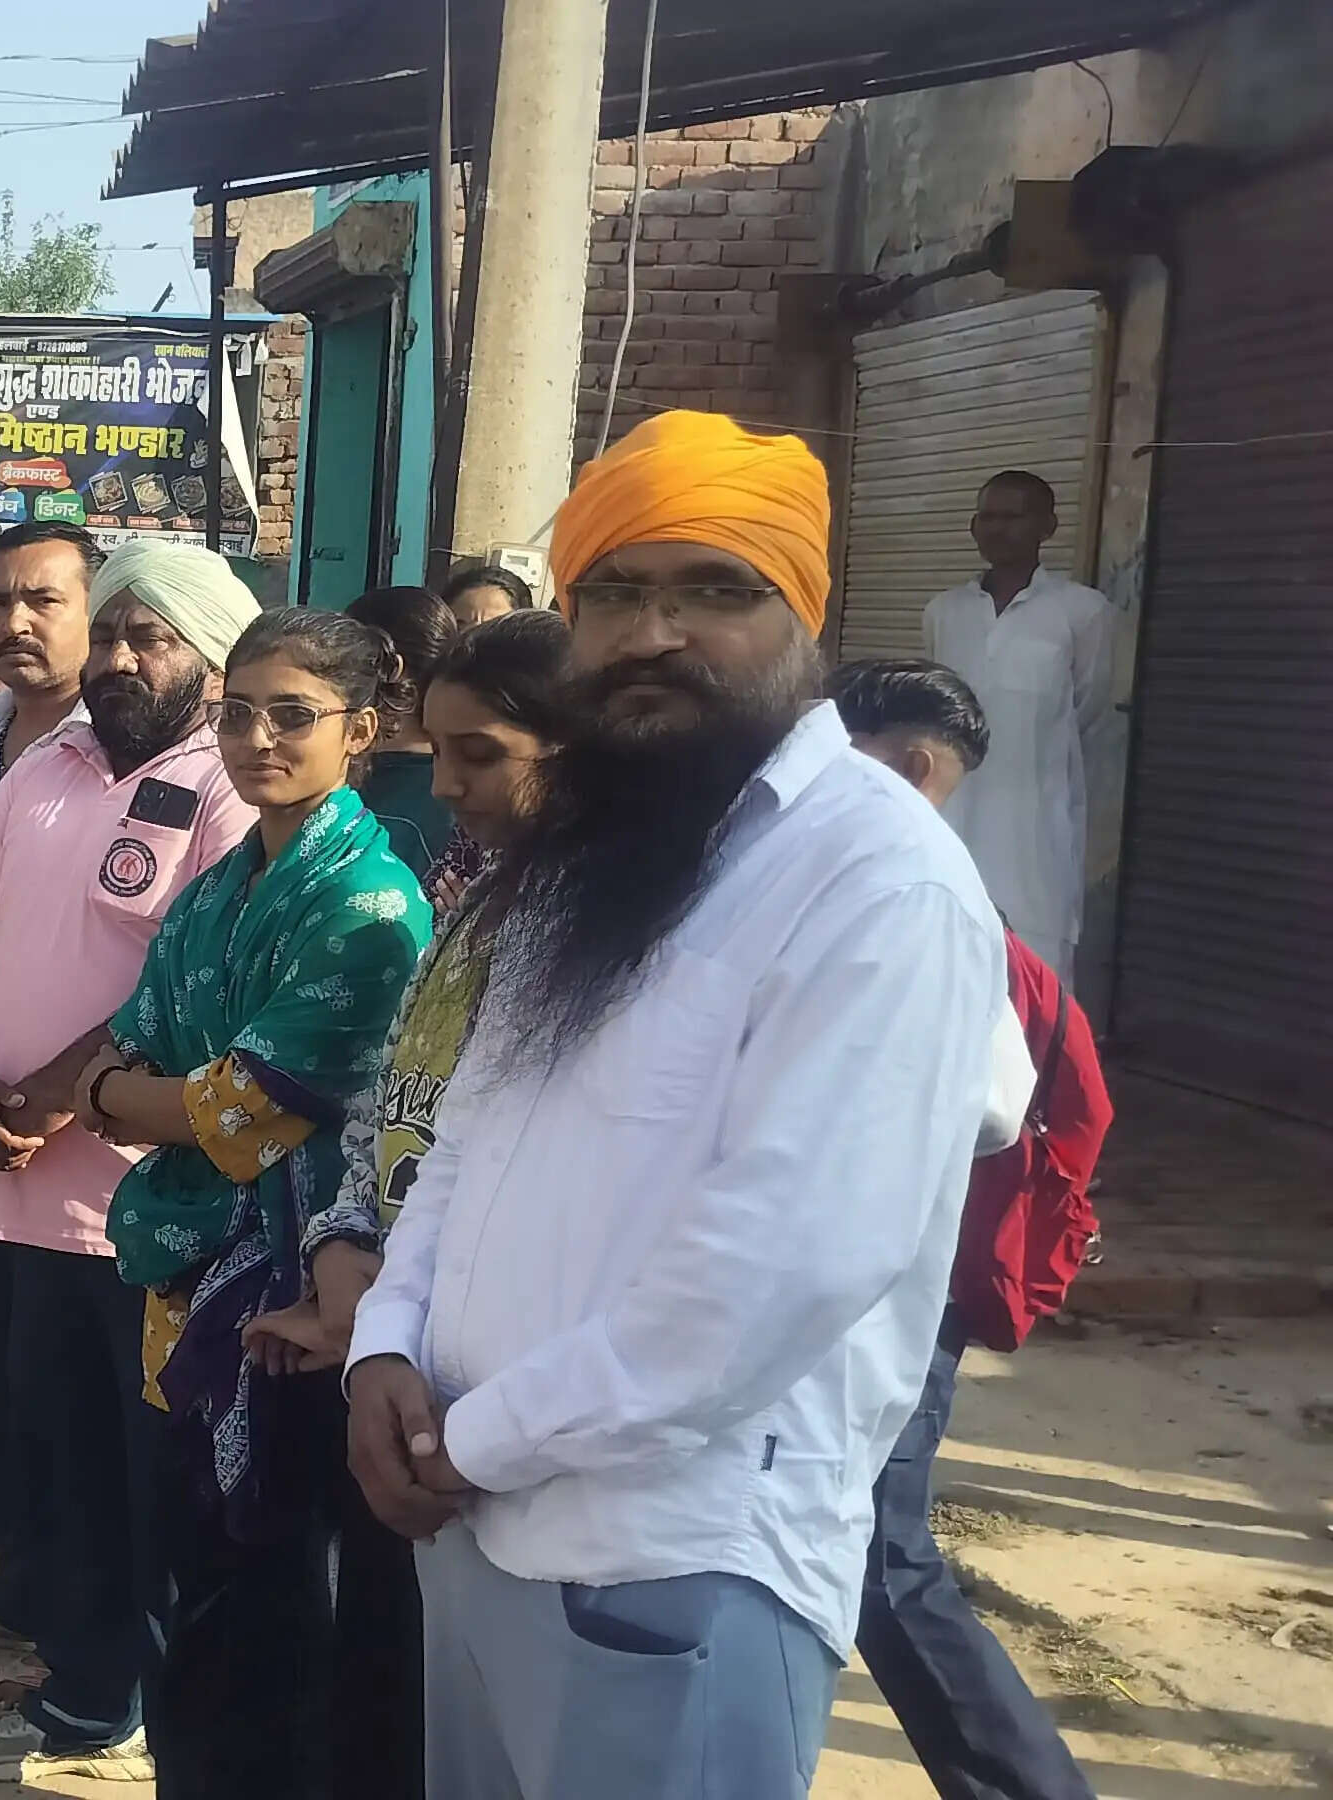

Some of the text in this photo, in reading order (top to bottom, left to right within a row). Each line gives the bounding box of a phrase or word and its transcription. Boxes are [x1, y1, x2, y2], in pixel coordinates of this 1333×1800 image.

[41, 356, 141, 403] शाकाहारी
[26, 403, 61, 420] एण्ड
[95, 423, 187, 459] भण्डार
[37, 494, 80, 517] डिनर
